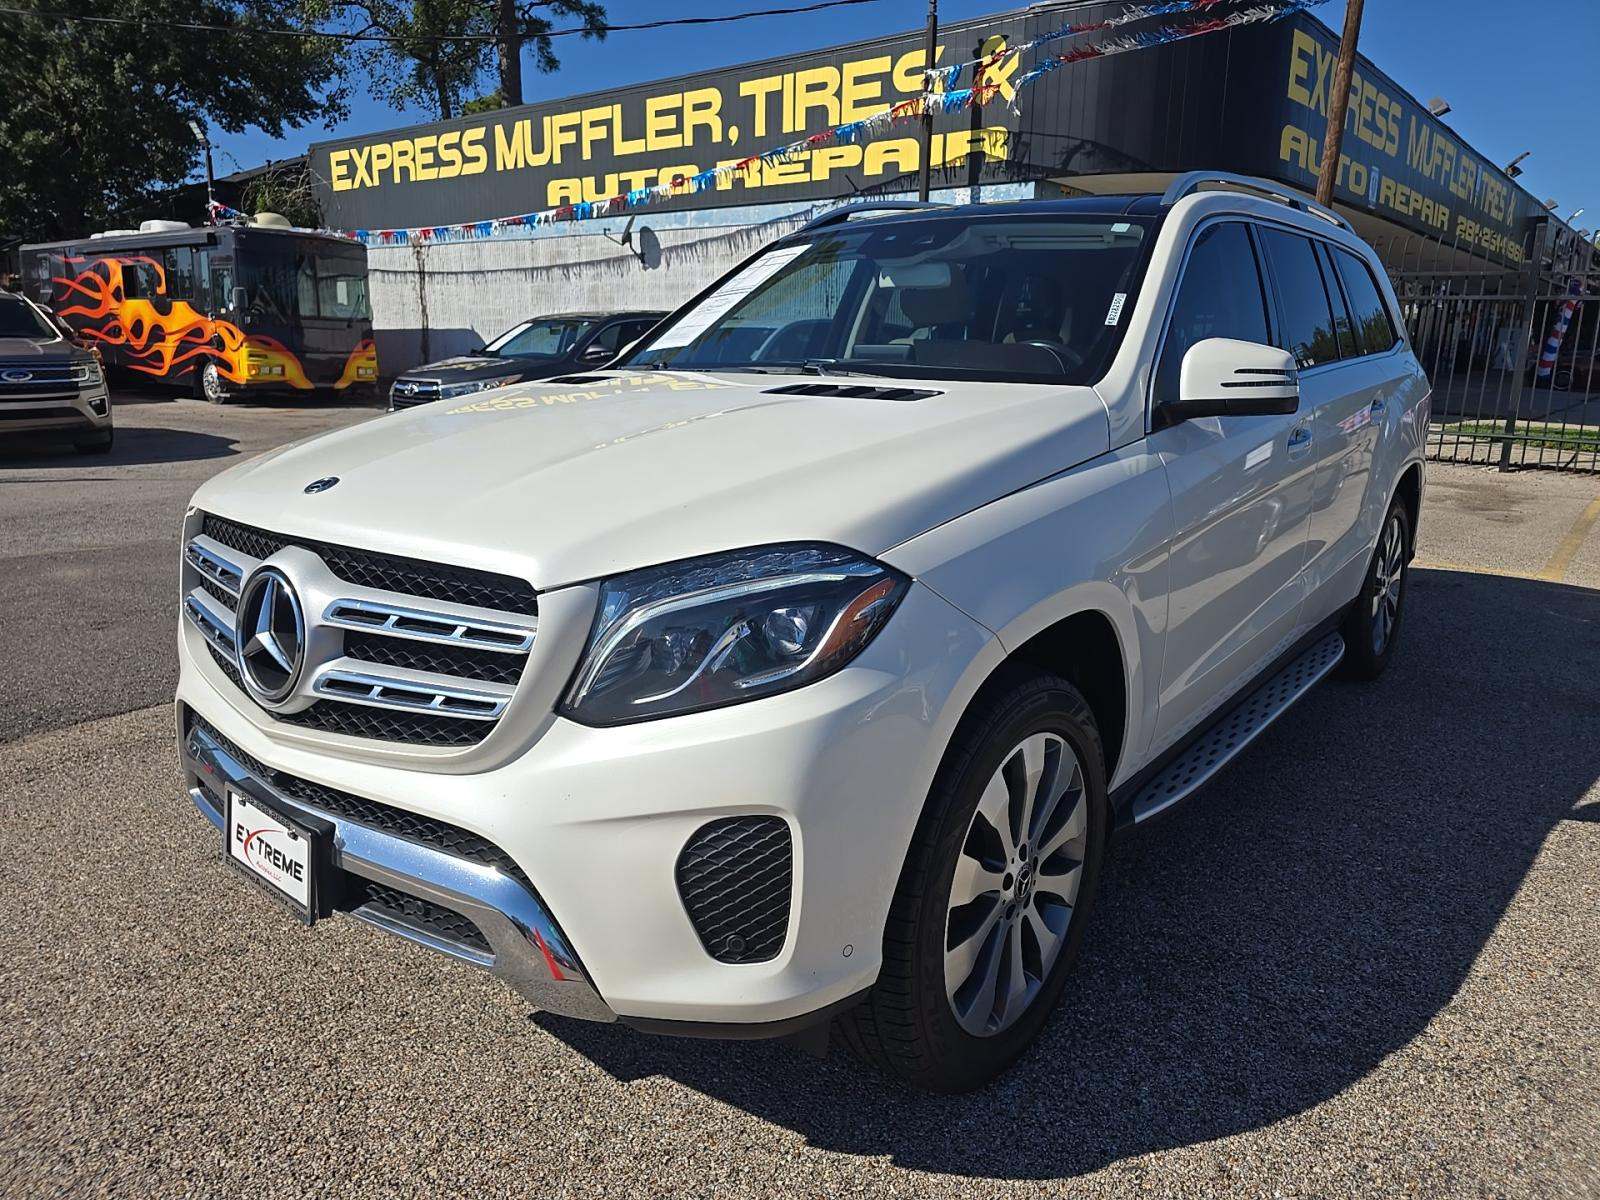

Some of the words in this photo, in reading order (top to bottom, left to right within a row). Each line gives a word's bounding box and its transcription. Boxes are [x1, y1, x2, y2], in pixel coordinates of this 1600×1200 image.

[330, 126, 488, 192] EXPRESS
[495, 87, 739, 172] MUFFLER,
[739, 46, 945, 138] TIRES
[976, 34, 1020, 105] &
[1287, 28, 1402, 157] EXRESS
[547, 164, 700, 207] AUTO
[716, 126, 1008, 191] REPAIR
[1379, 175, 1450, 232] REPAIR
[236, 823, 304, 883] EXTREME
